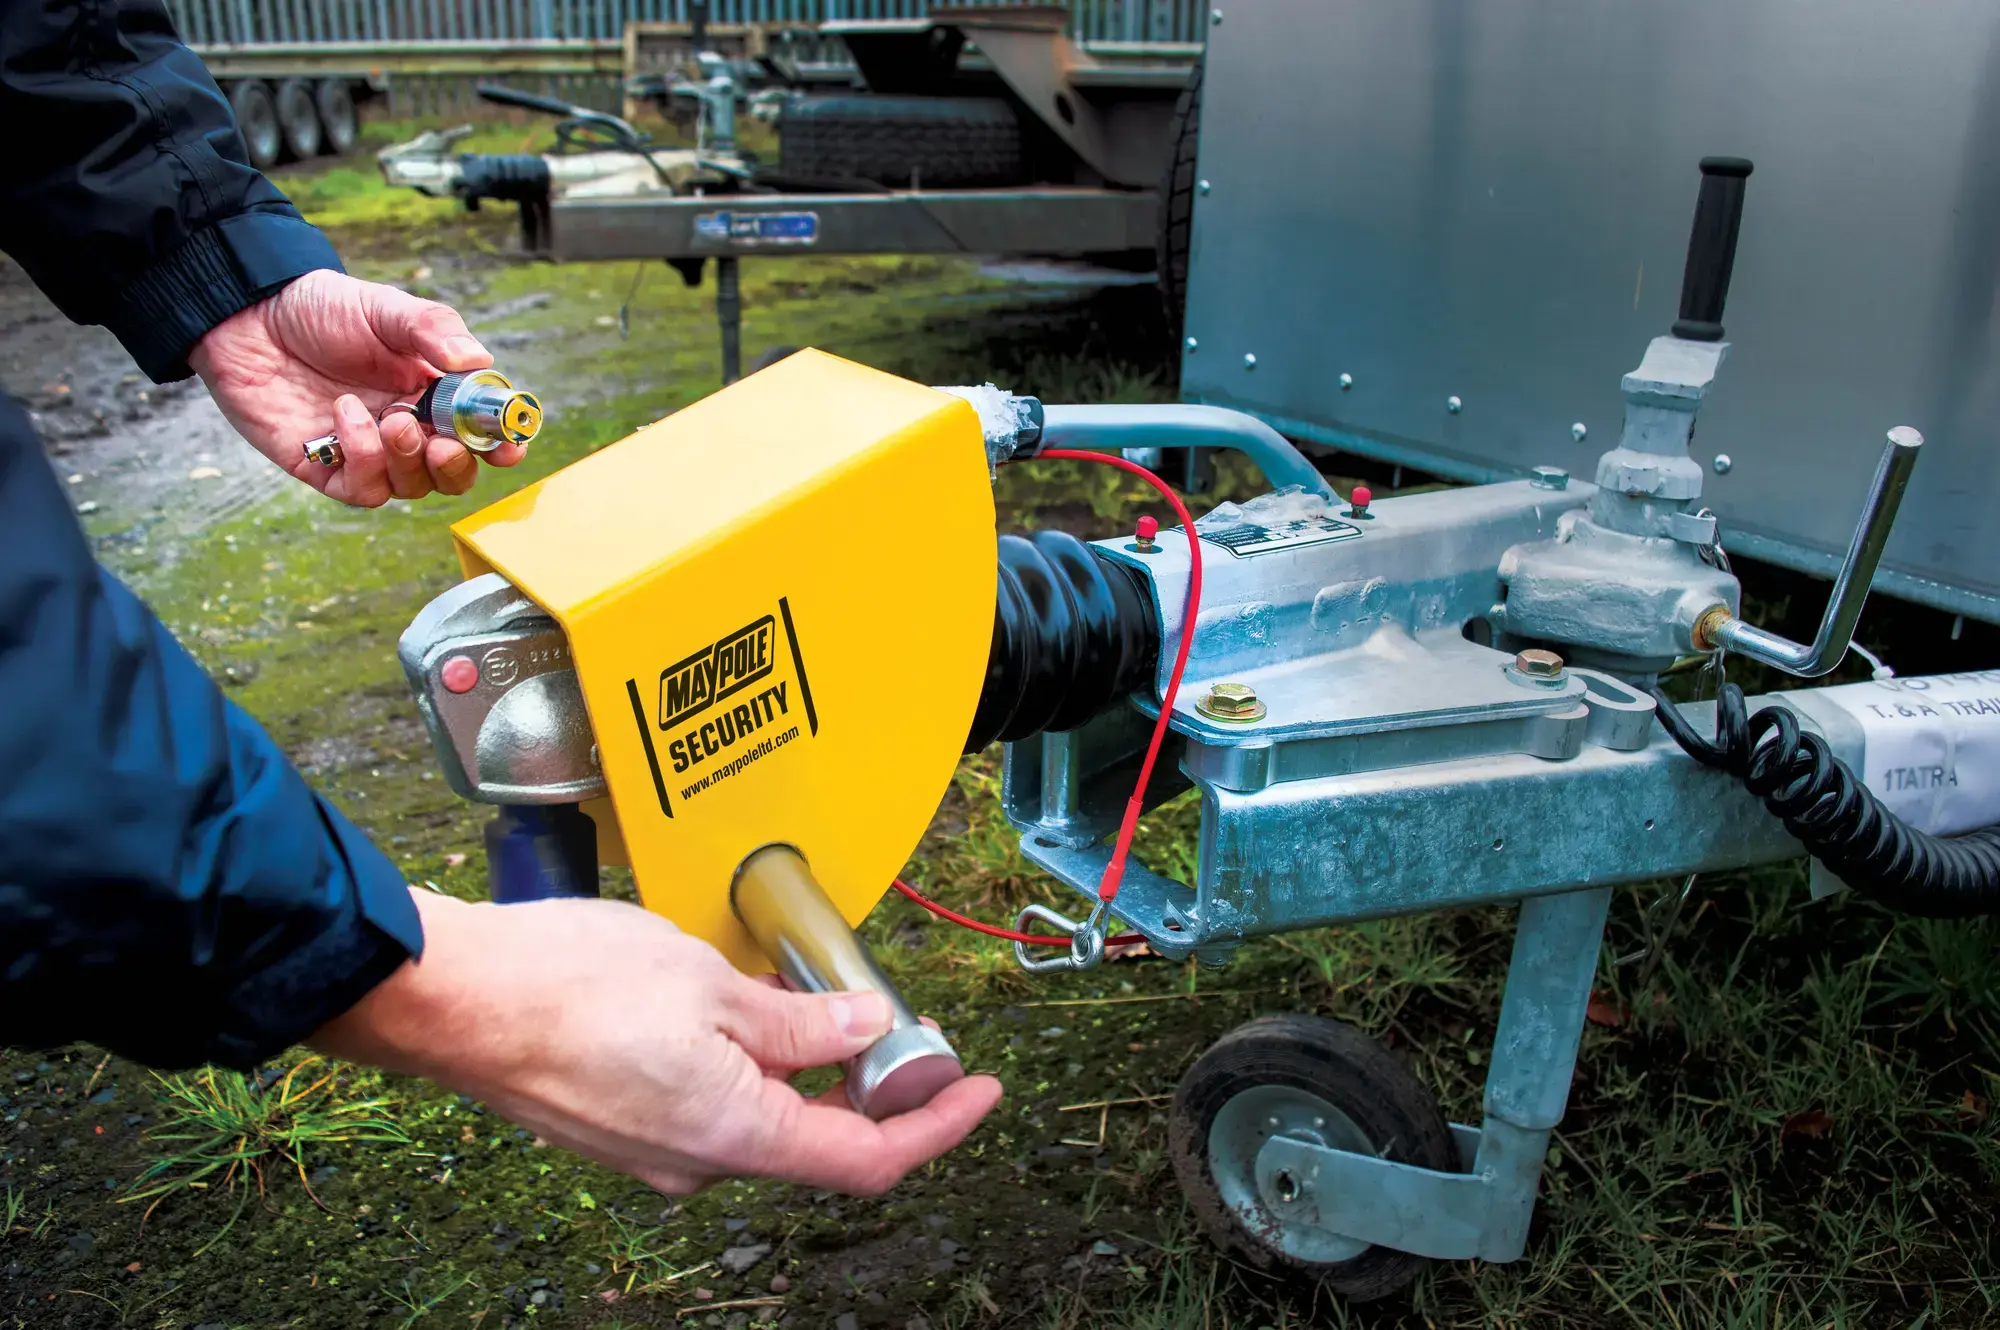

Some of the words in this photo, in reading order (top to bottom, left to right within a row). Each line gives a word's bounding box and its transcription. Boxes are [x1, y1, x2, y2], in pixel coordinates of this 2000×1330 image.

[666, 626, 768, 719] MAYPOLE
[669, 680, 789, 774] SECURITY
[681, 726, 800, 801] www.maypoleltd.com
